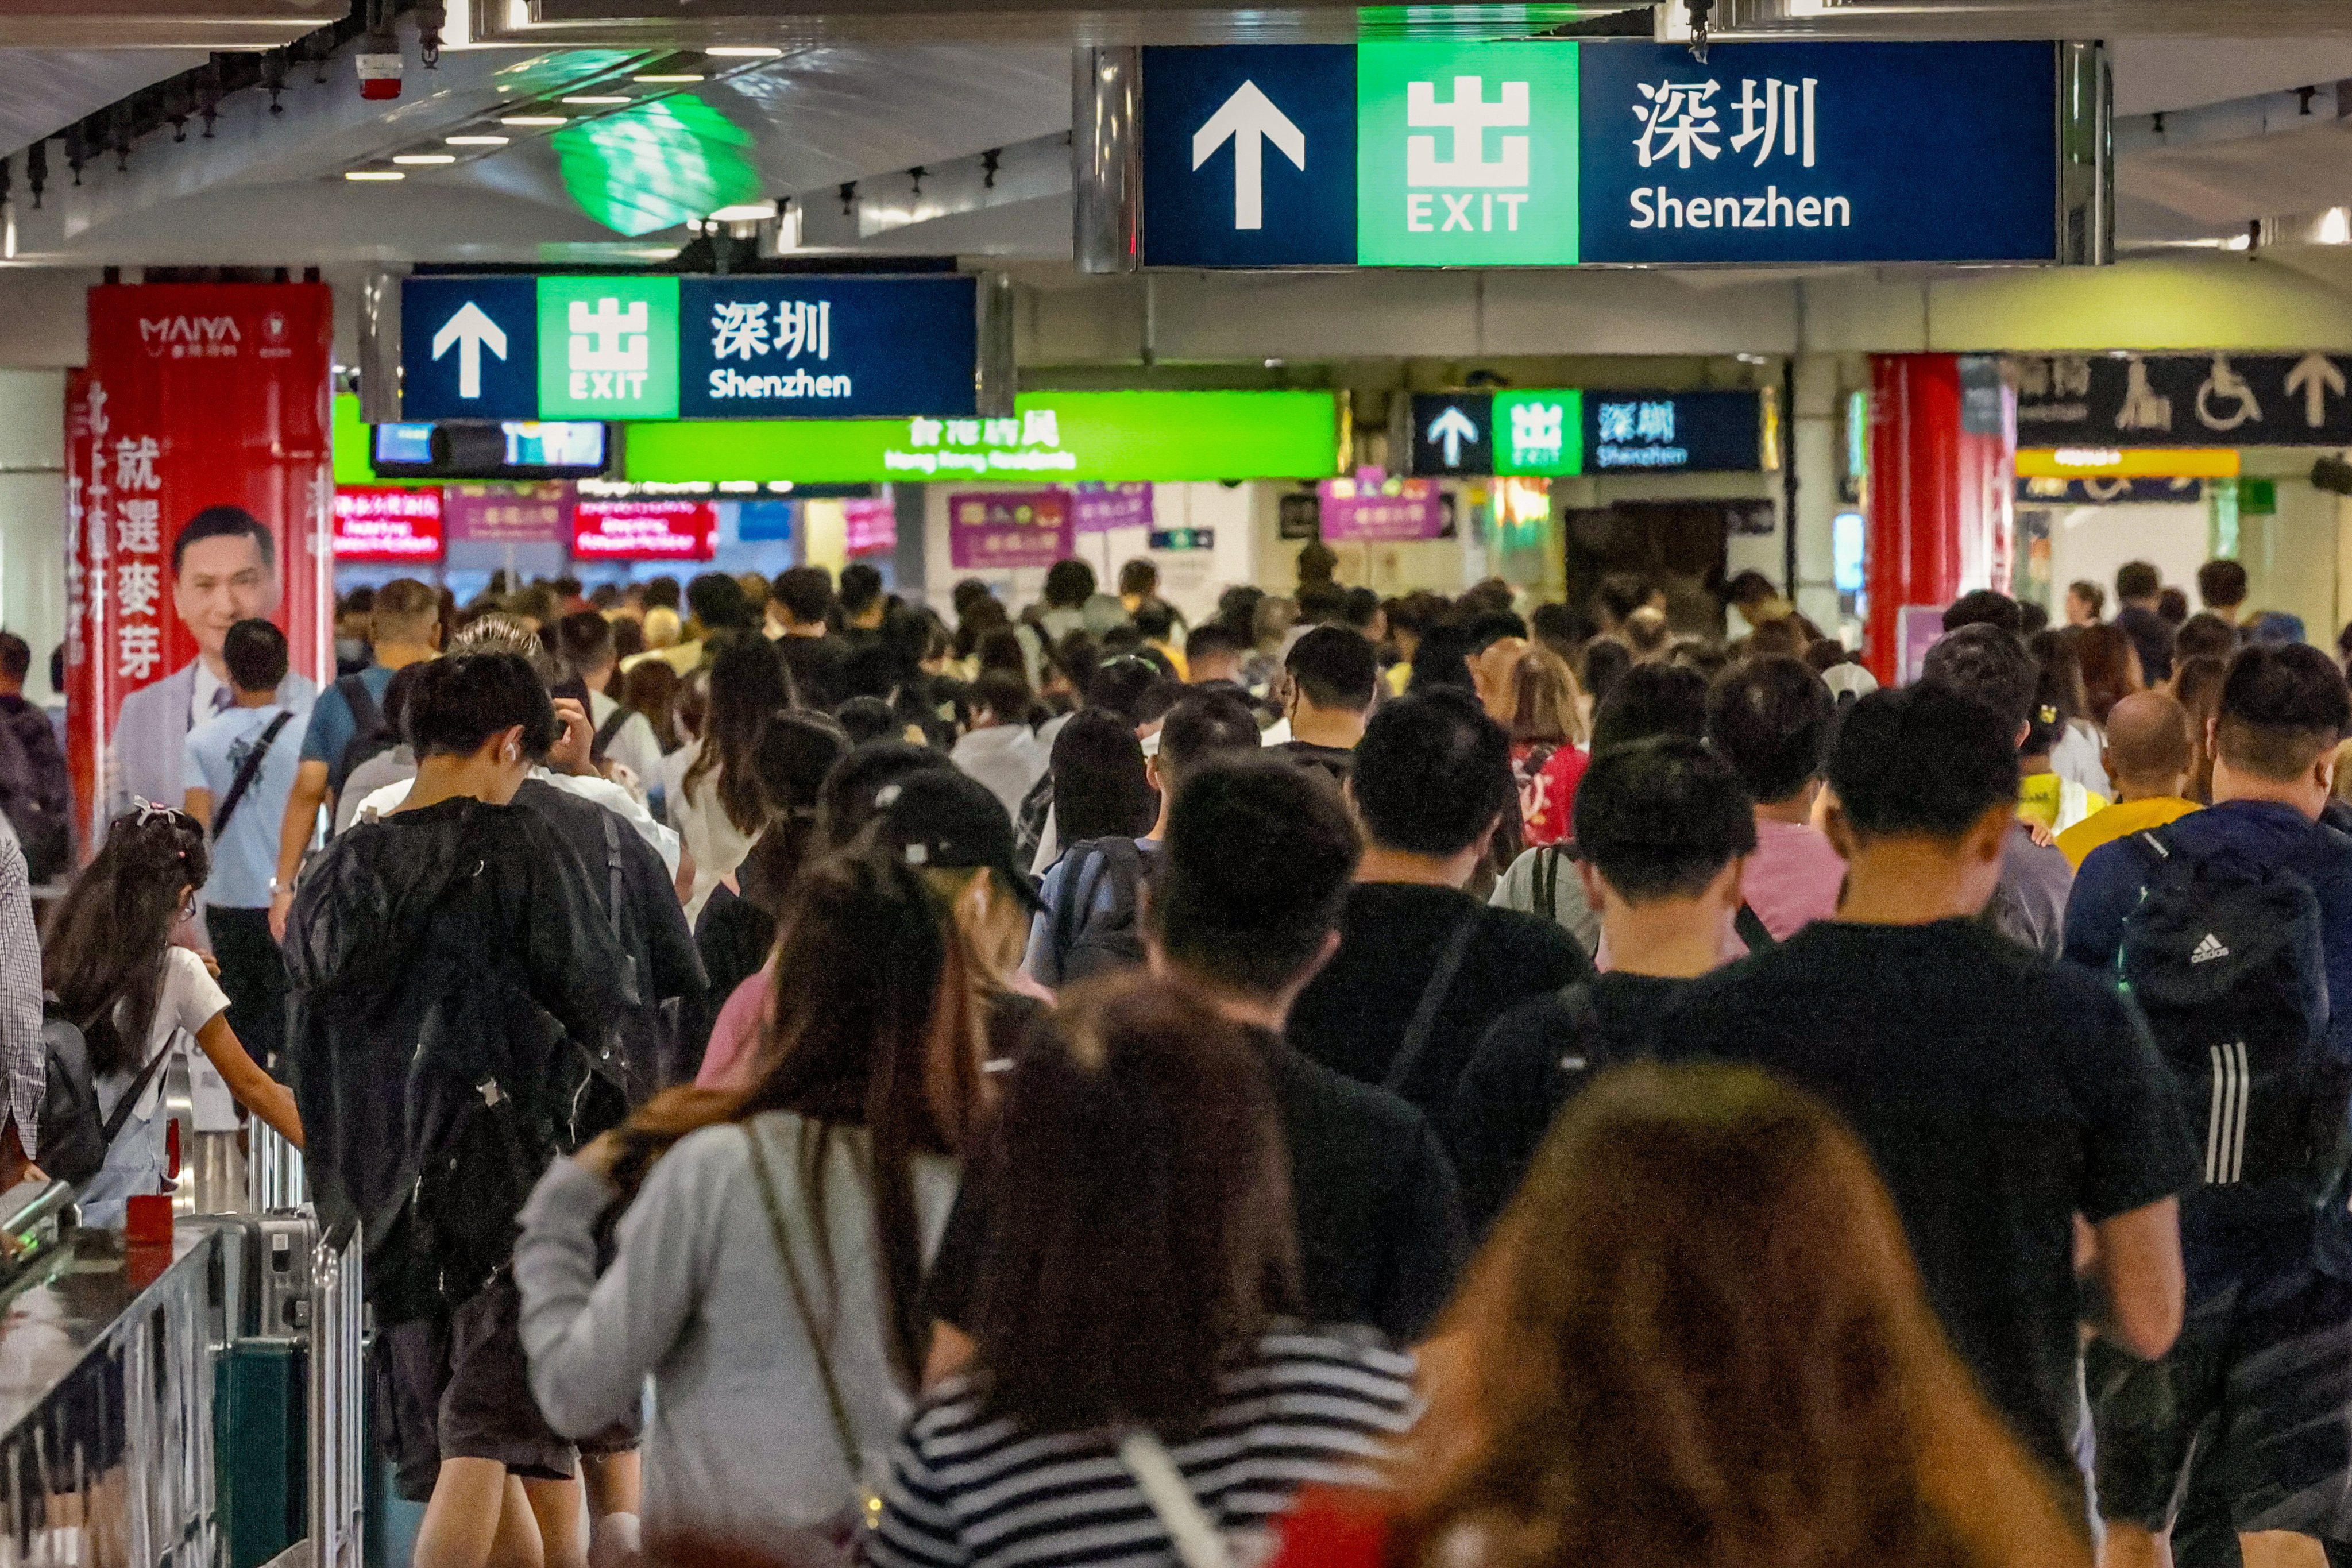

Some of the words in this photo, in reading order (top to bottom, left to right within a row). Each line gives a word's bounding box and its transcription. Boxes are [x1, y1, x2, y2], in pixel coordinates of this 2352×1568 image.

[1407, 76, 1529, 187] 出
[1632, 78, 1818, 169] 深圳
[1407, 193, 1528, 232] EXIT
[1629, 185, 1850, 229] Shenzhen
[139, 315, 241, 342] MAIYA
[569, 298, 648, 370] 出
[711, 301, 830, 360] 深圳
[569, 372, 648, 399] EXIT
[709, 368, 851, 397] Shenzhen
[1511, 402, 1562, 449] 出
[1598, 401, 1674, 443] 深圳
[116, 436, 161, 679] 就選麥芽
[2191, 948, 2229, 963] adidas
